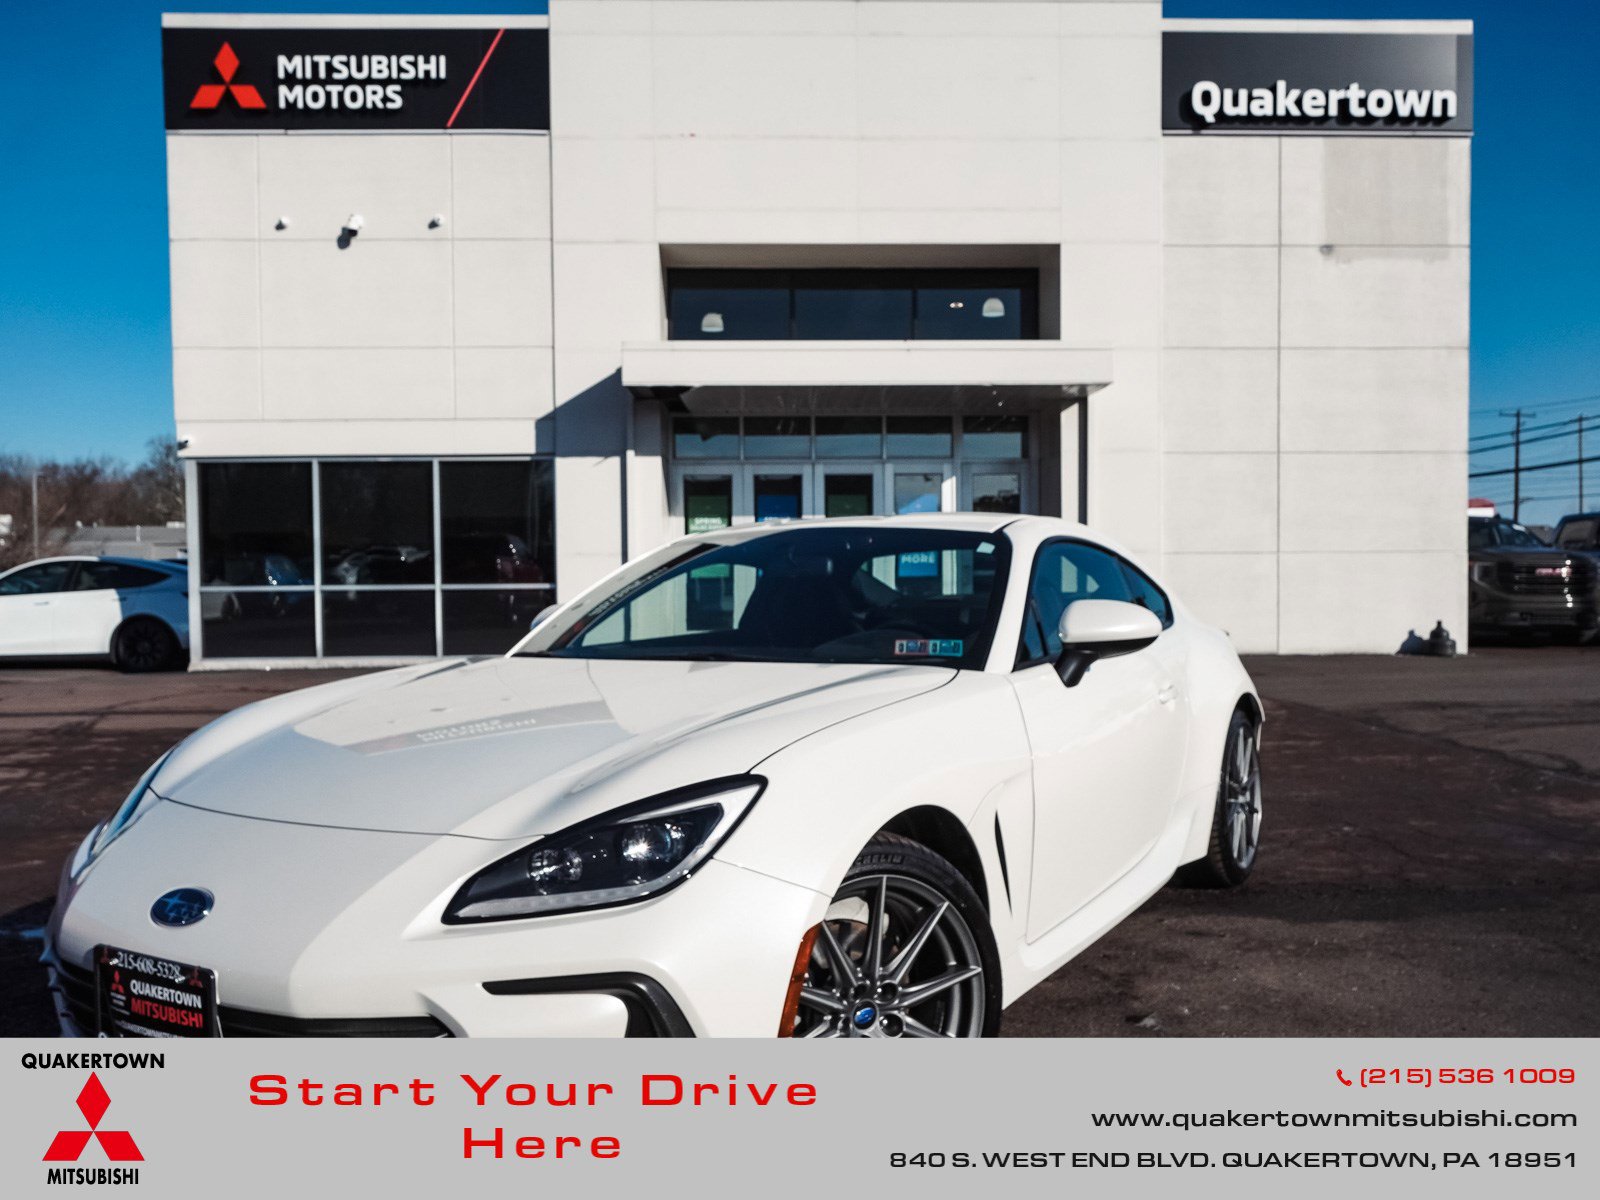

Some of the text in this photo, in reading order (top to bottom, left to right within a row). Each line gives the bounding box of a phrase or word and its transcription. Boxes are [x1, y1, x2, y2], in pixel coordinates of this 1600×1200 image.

[277, 54, 447, 80] MITSUBISHI
[277, 84, 404, 110] MOTORS
[1191, 80, 1458, 123] Quakertown
[901, 554, 936, 564] MORE
[129, 979, 203, 1009] QUAKERTOWN
[130, 997, 204, 1029] MITSUBISHI
